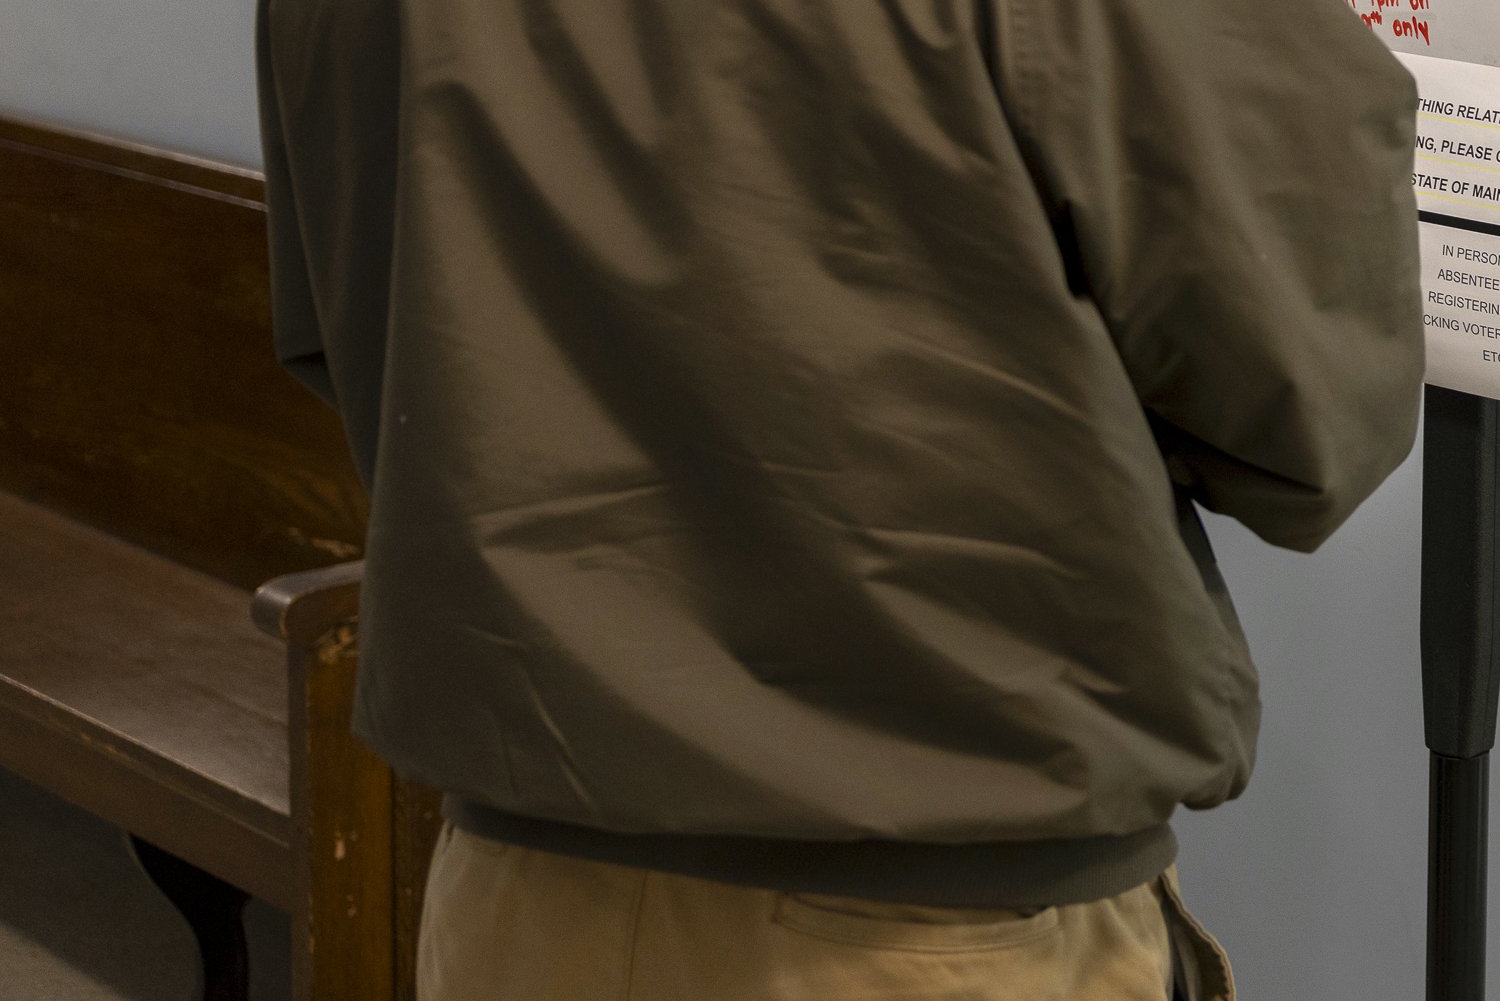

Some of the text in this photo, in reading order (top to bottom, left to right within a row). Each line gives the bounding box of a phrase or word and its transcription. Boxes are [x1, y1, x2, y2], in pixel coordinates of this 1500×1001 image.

[1393, 16, 1430, 46] only
[1441, 140, 1493, 161] PLEASE
[1411, 173, 1448, 192] STATE
[1451, 180, 1469, 195] OF
[1442, 244, 1454, 257] IN
[1437, 268, 1500, 291] ABSENTEE
